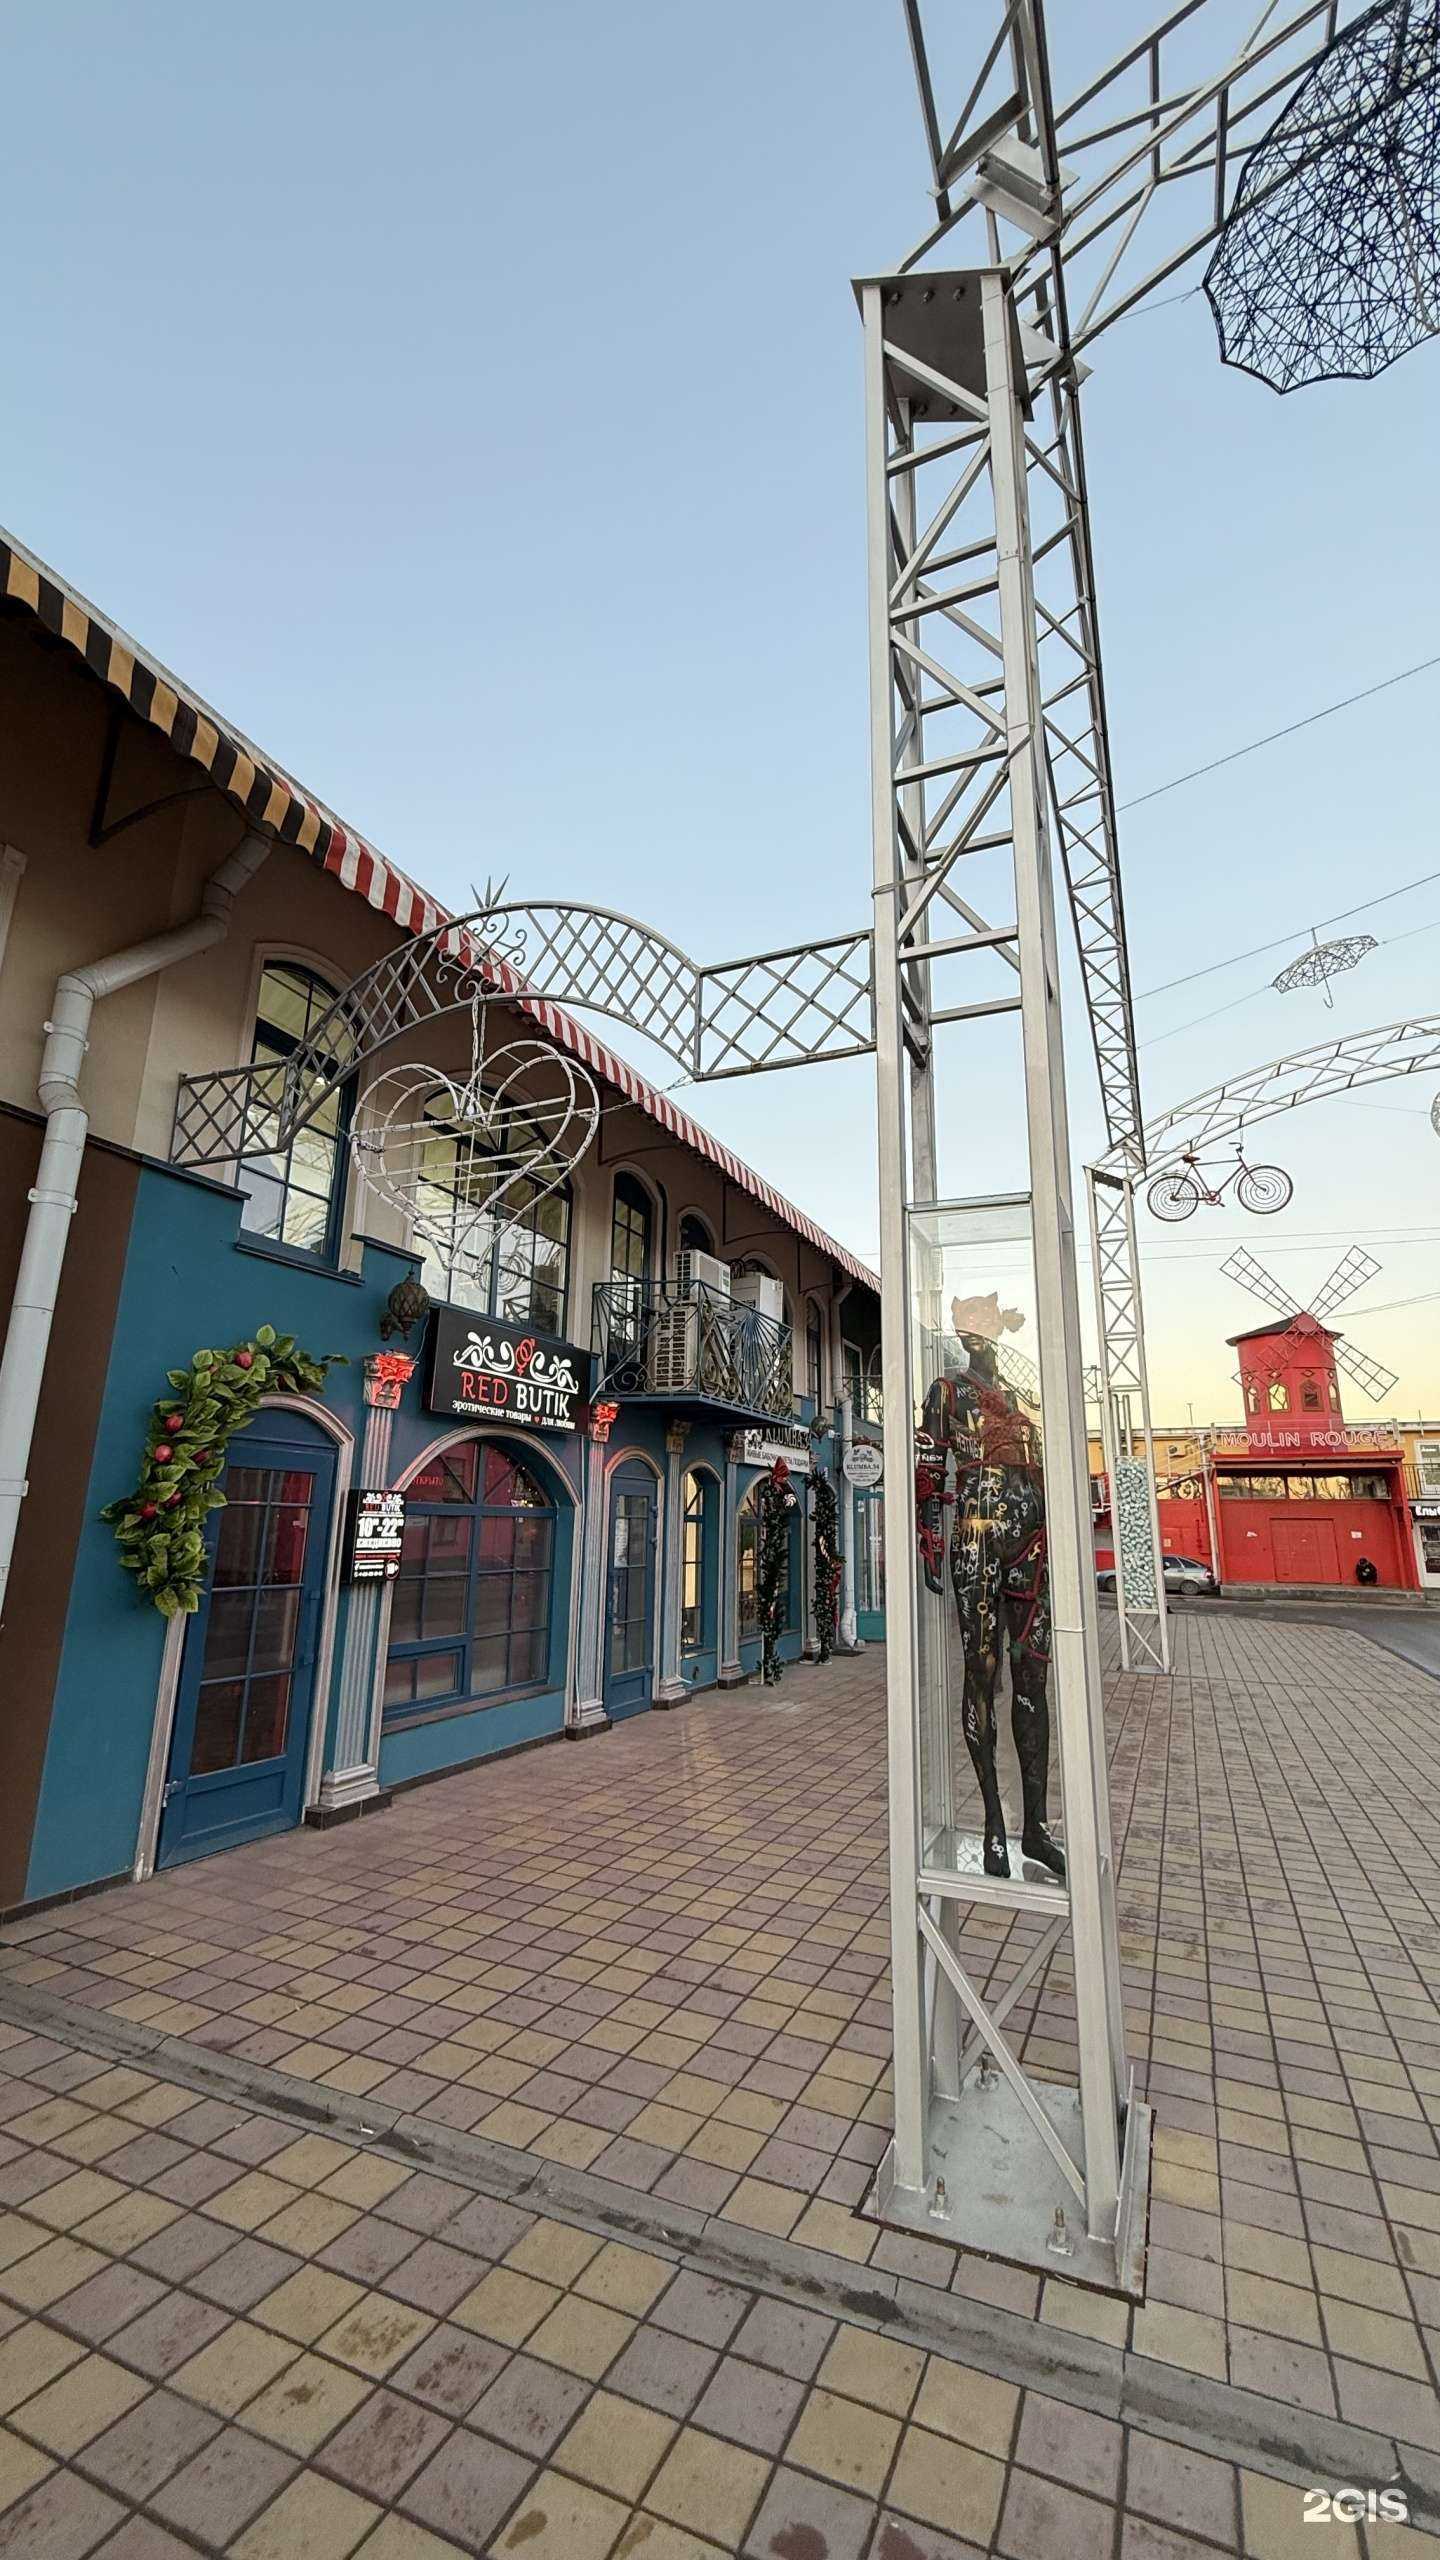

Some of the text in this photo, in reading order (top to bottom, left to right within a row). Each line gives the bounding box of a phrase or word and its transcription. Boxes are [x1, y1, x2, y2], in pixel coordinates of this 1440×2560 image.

[461, 1371, 571, 1418] RED BUTIK
[1220, 1430, 1387, 1448] MOULIN ROUGE
